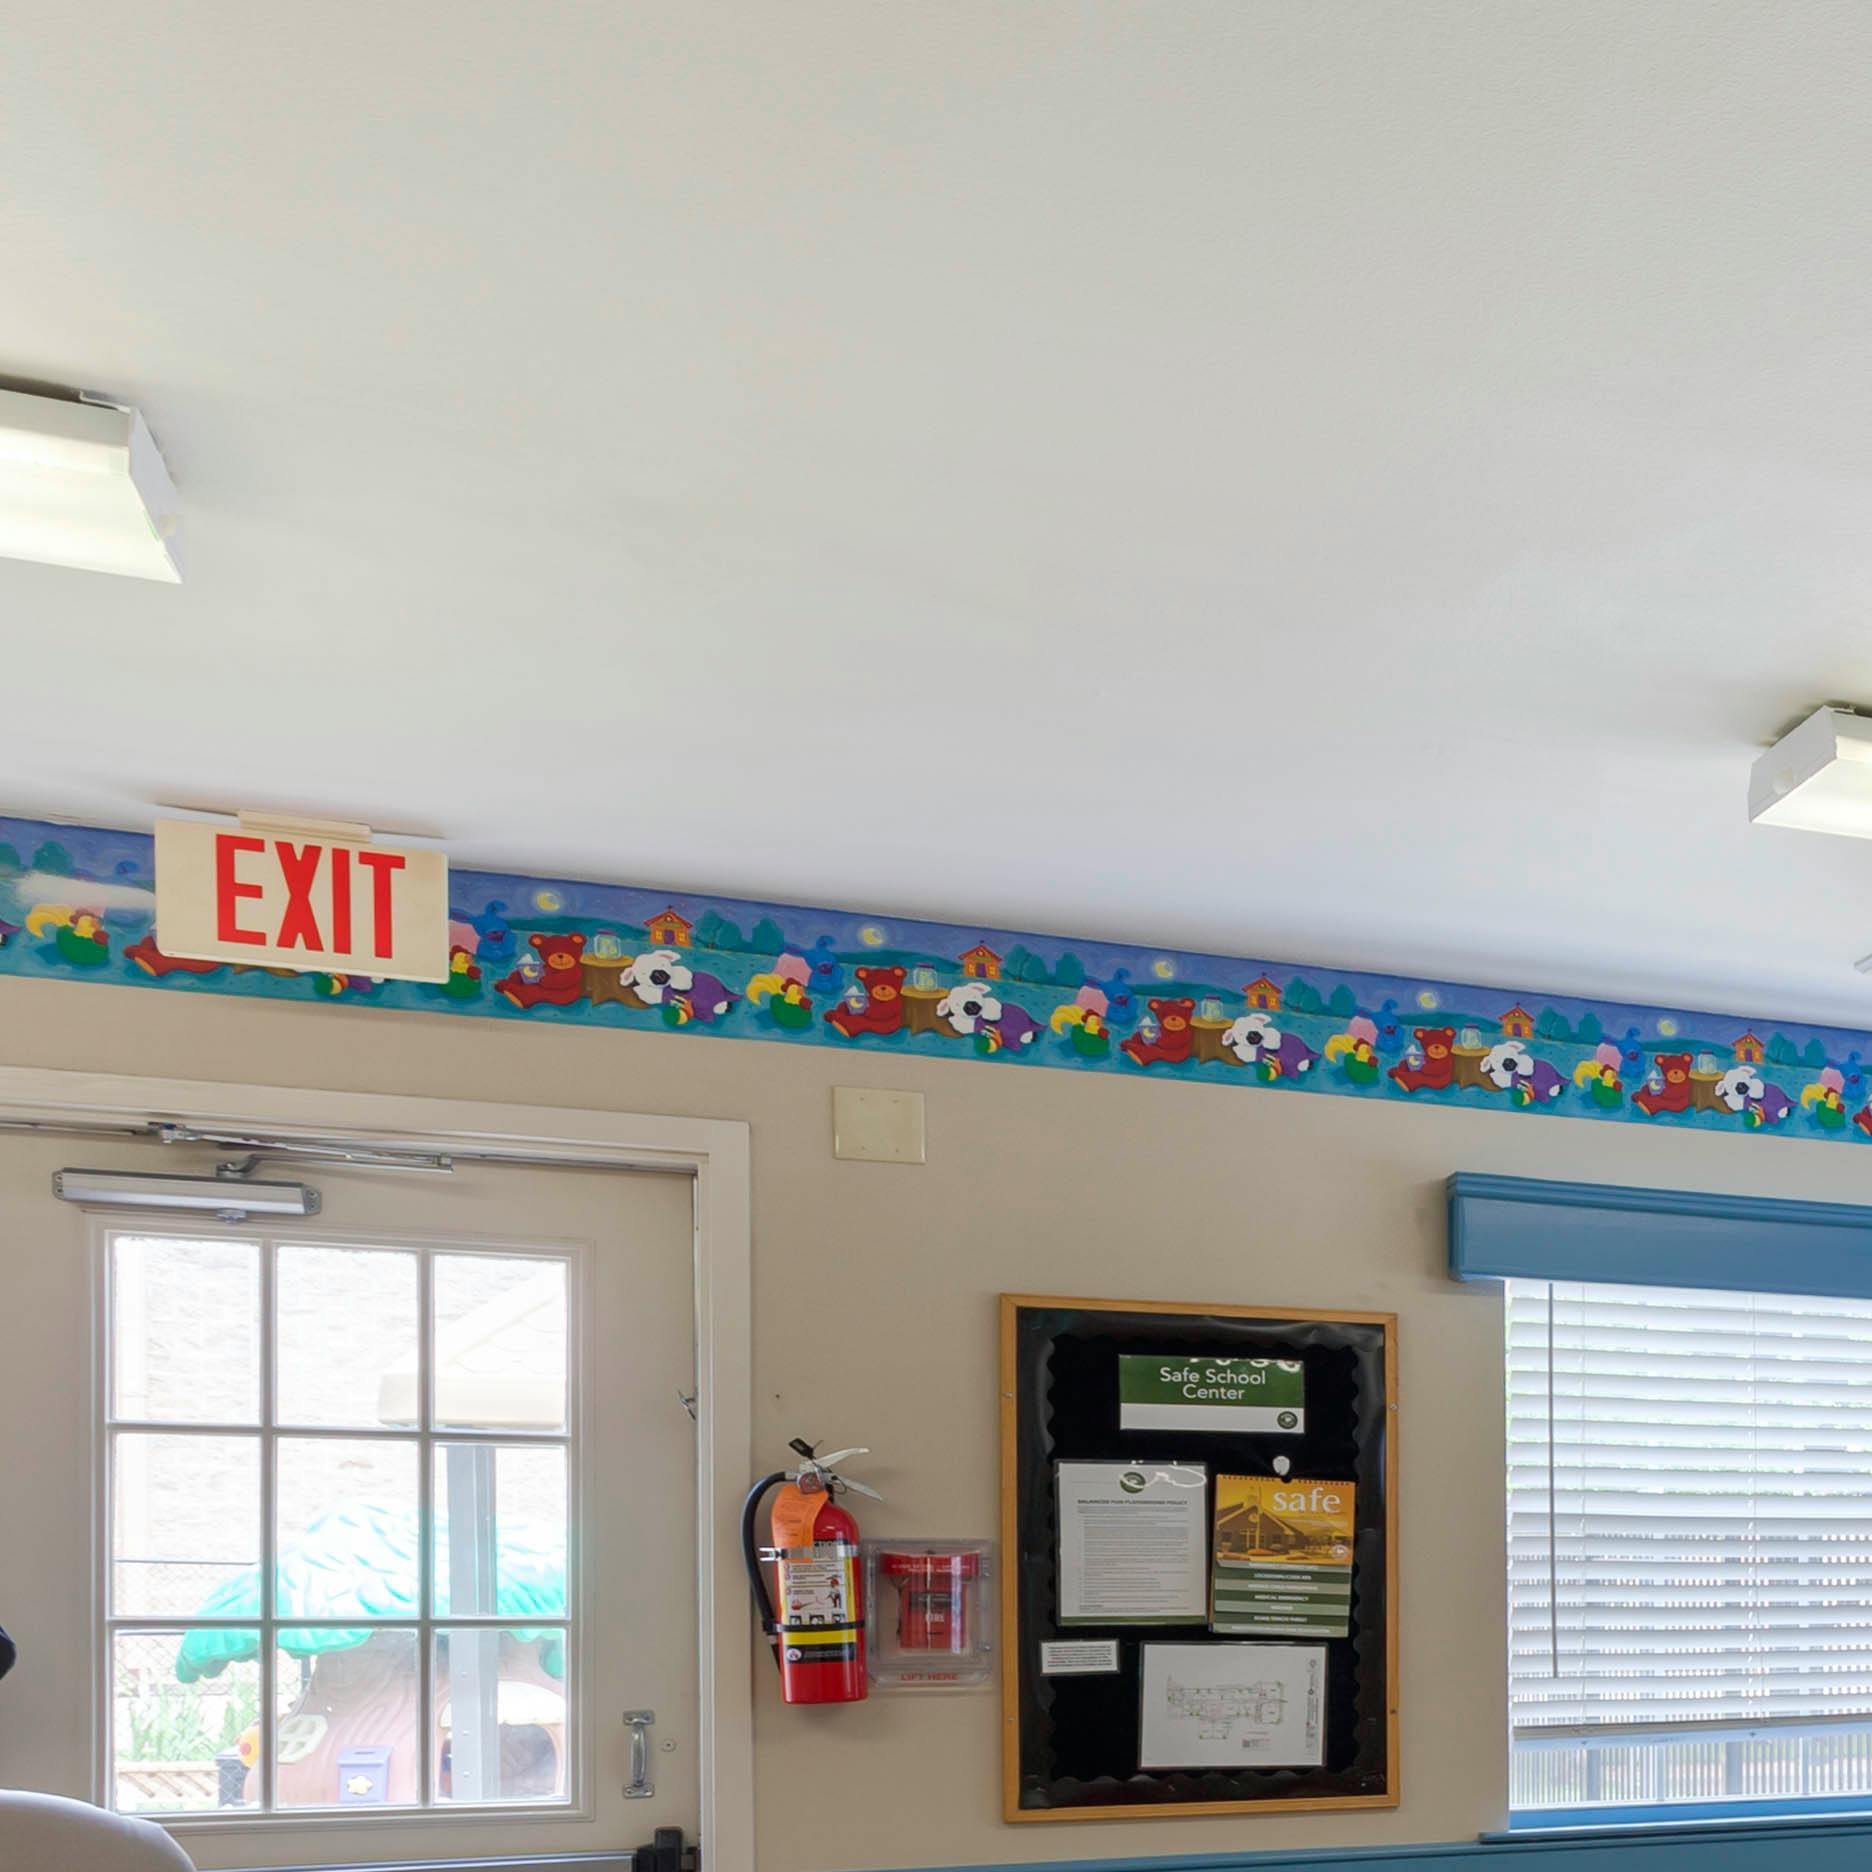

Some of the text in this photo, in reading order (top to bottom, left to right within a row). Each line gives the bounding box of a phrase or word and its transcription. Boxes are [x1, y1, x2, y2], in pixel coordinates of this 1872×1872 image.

[216, 834, 405, 959] EXIT
[1160, 1367, 1266, 1384] Safe School
[1182, 1383, 1245, 1400] Center
[1273, 1487, 1341, 1514] safe
